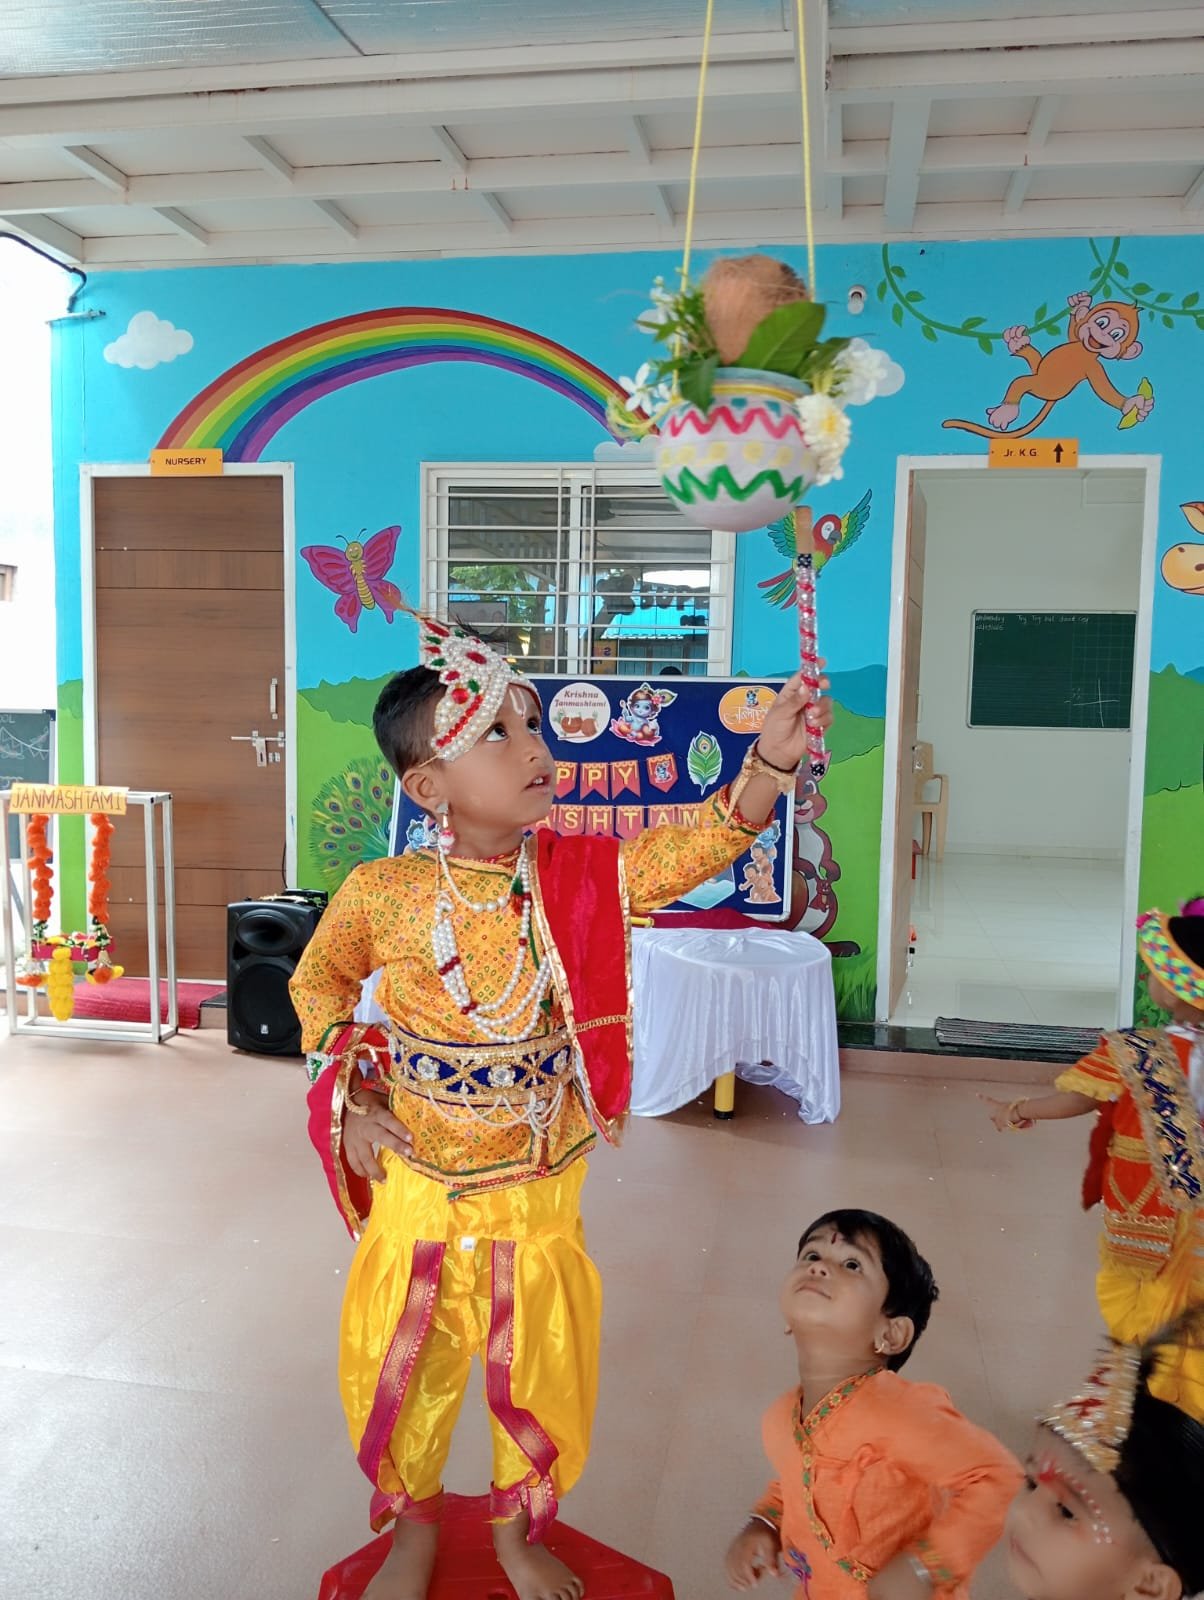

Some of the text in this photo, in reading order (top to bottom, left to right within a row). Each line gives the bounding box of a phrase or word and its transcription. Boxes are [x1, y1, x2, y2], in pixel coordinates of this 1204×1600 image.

[165, 457, 207, 466] NURSERY
[564, 689, 599, 698] Krishna
[554, 699, 606, 708] Janmashtami
[556, 767, 633, 787] PPY
[12, 787, 122, 811] JANMASHTAMI
